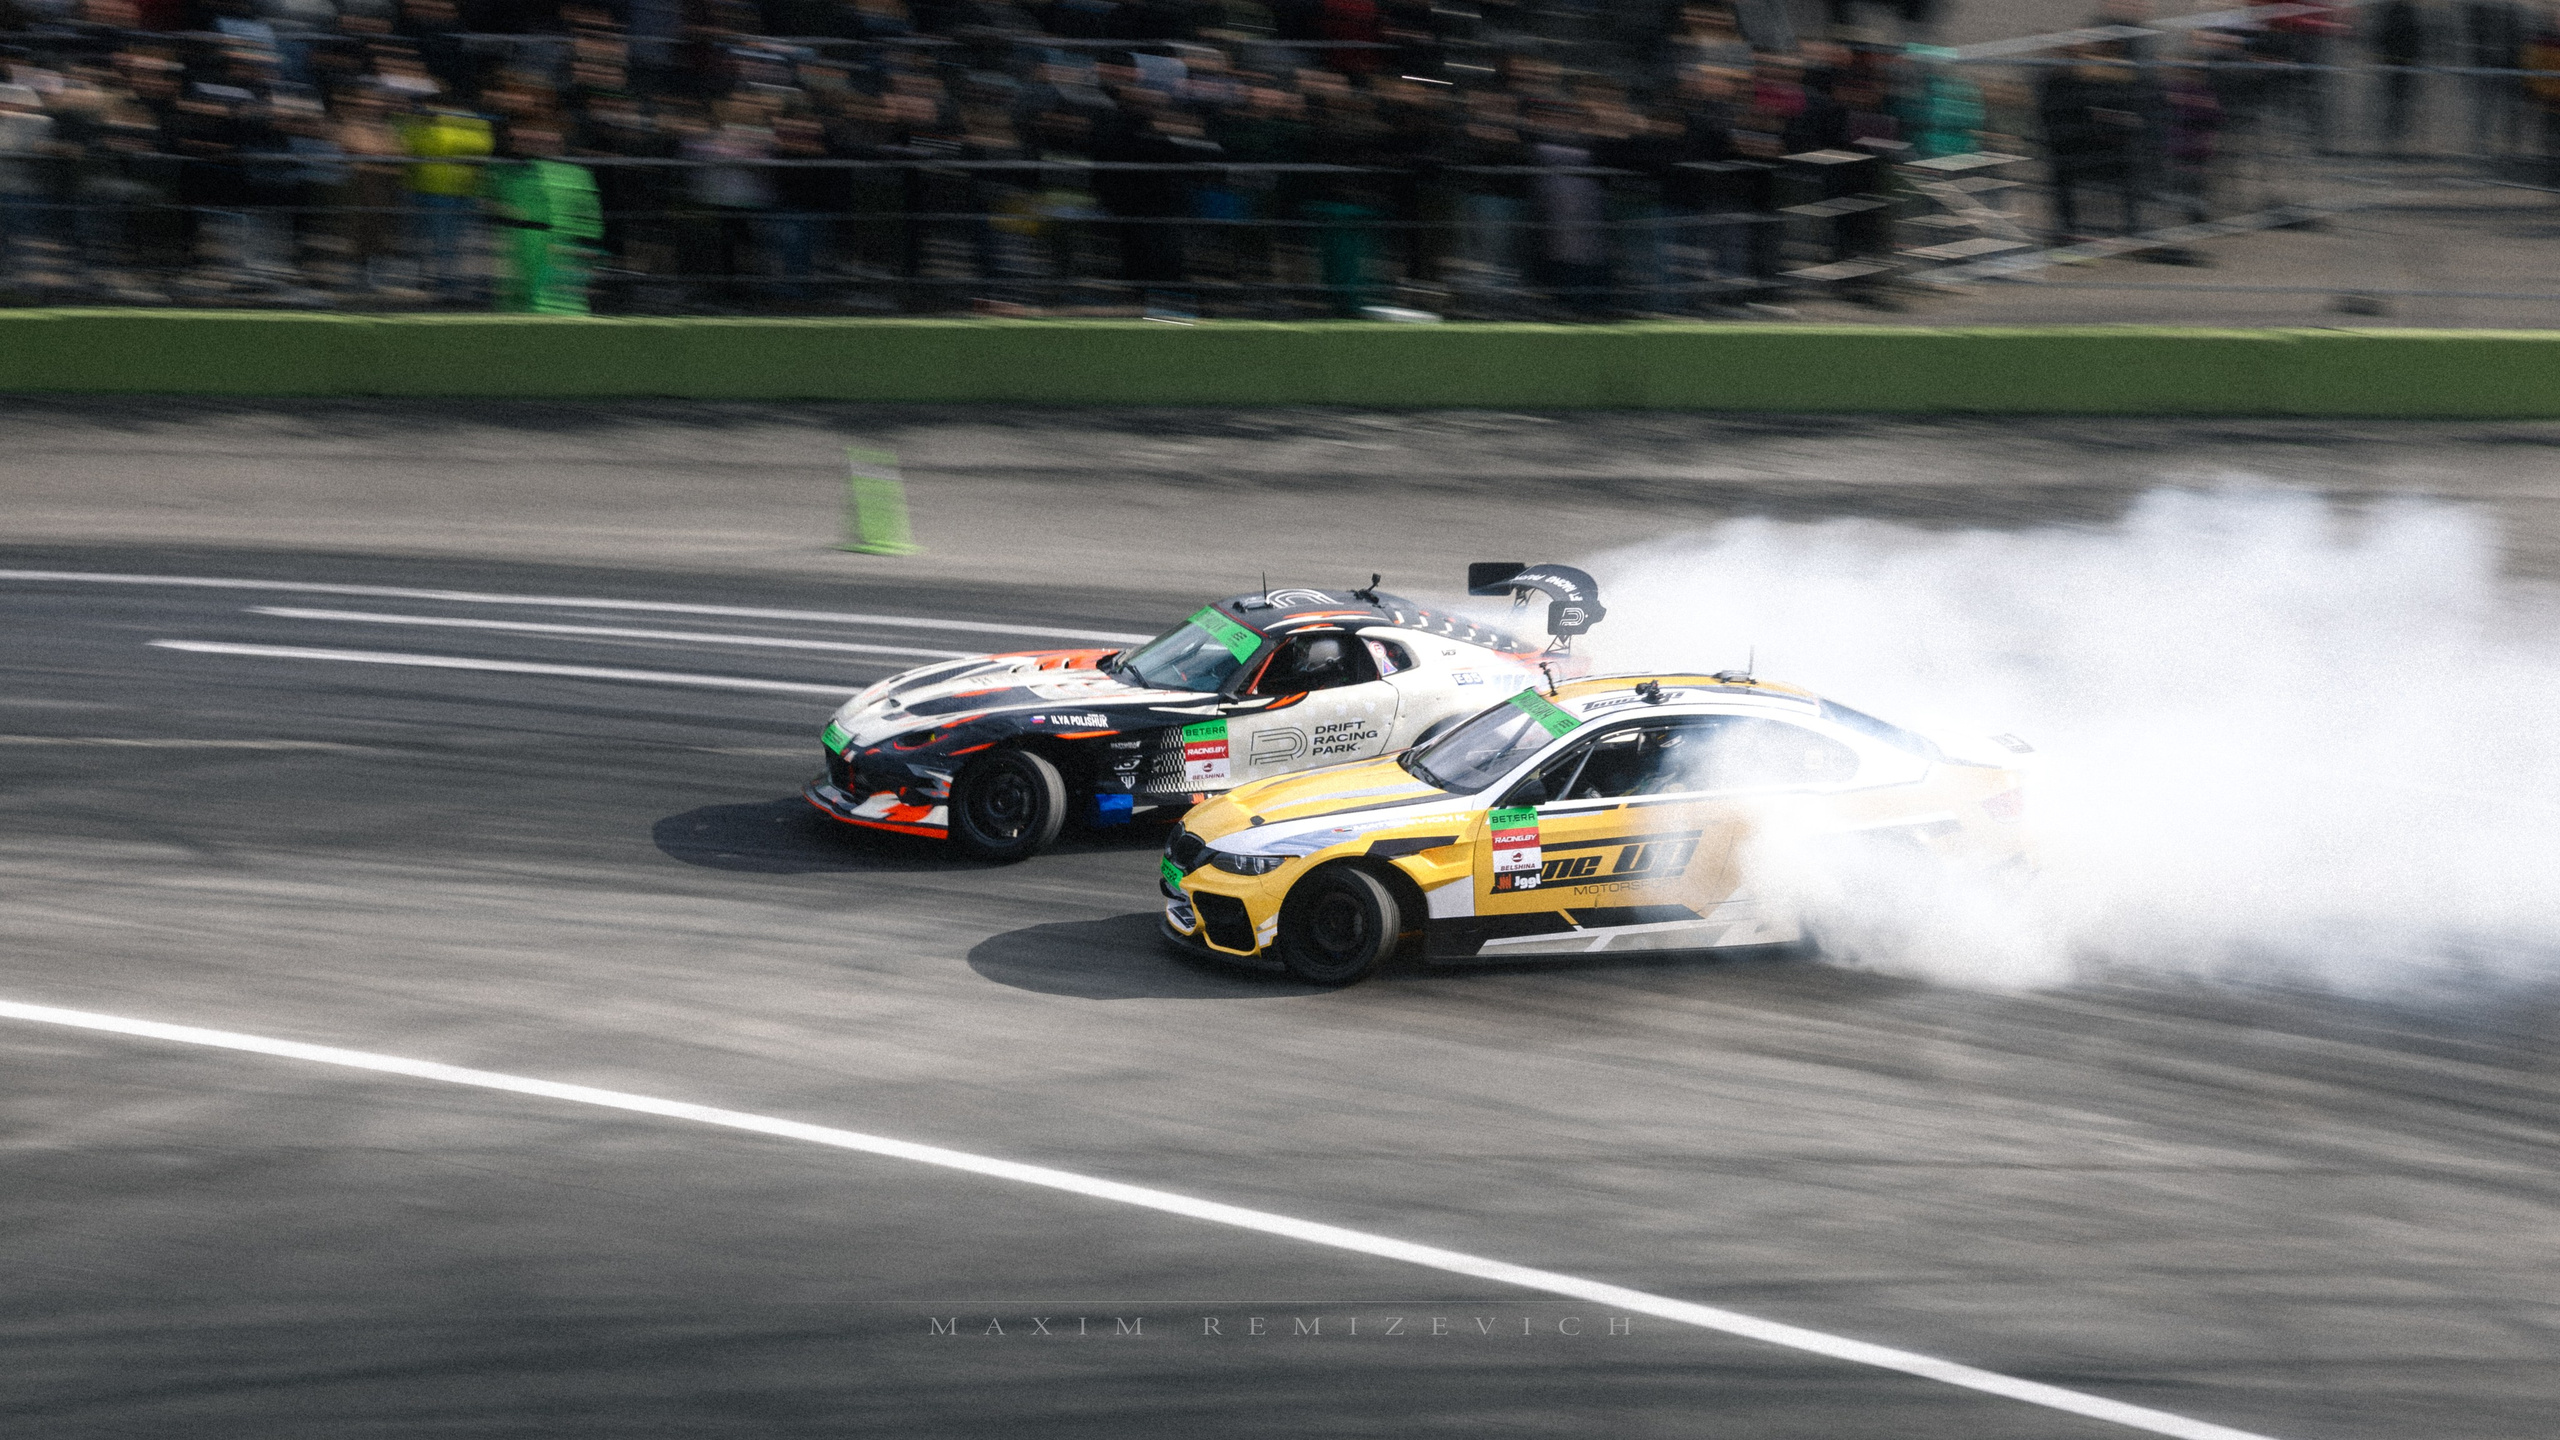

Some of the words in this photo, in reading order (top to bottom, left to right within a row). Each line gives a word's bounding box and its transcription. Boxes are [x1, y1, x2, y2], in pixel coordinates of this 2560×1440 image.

[1050, 714, 1070, 725] ILYA
[1069, 714, 1109, 728] POLISHUK
[1185, 726, 1226, 737] BETERA
[1315, 720, 1366, 735] DRIFT
[1313, 730, 1378, 745] RACING
[1312, 742, 1361, 756] PARK.
[1192, 772, 1225, 780] BELSHINA
[1492, 813, 1536, 824] BETERA
[1500, 863, 1536, 872] BELSHINA
